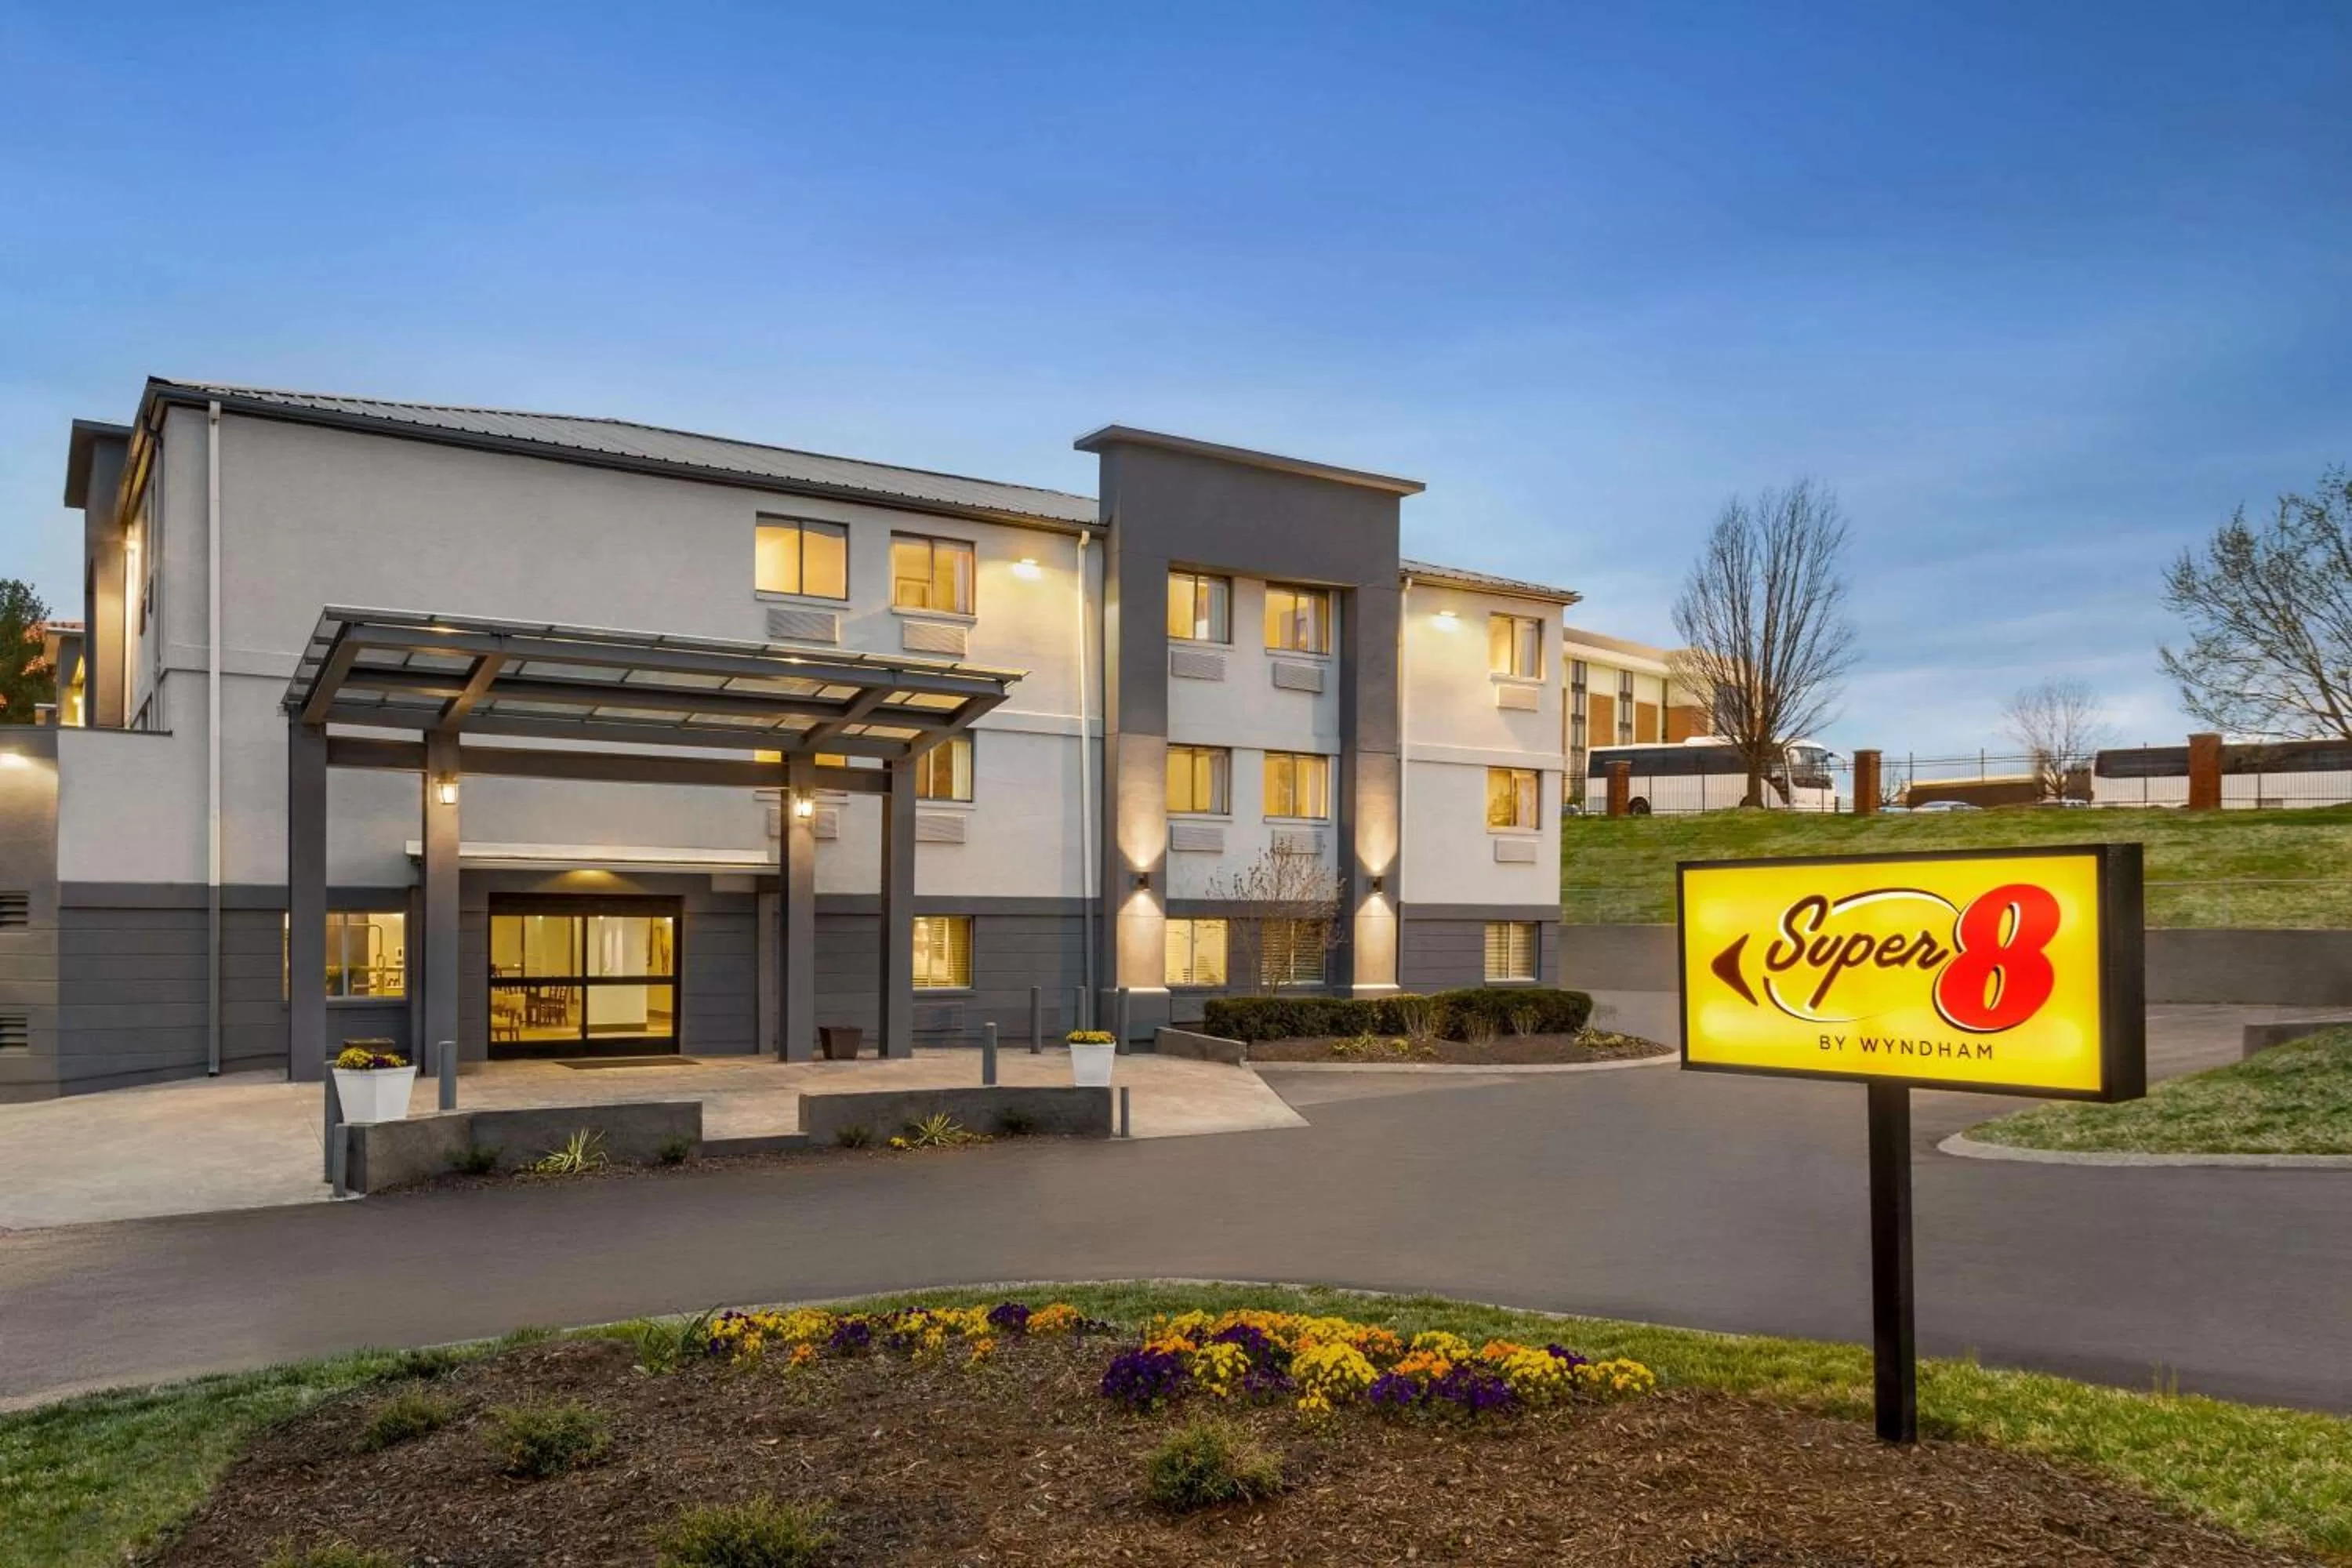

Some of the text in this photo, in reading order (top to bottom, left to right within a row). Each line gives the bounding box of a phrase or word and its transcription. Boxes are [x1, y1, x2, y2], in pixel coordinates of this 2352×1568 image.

[1765, 883, 2061, 1034] Super 8
[1819, 1034, 1994, 1060] BY WYNDHAM
